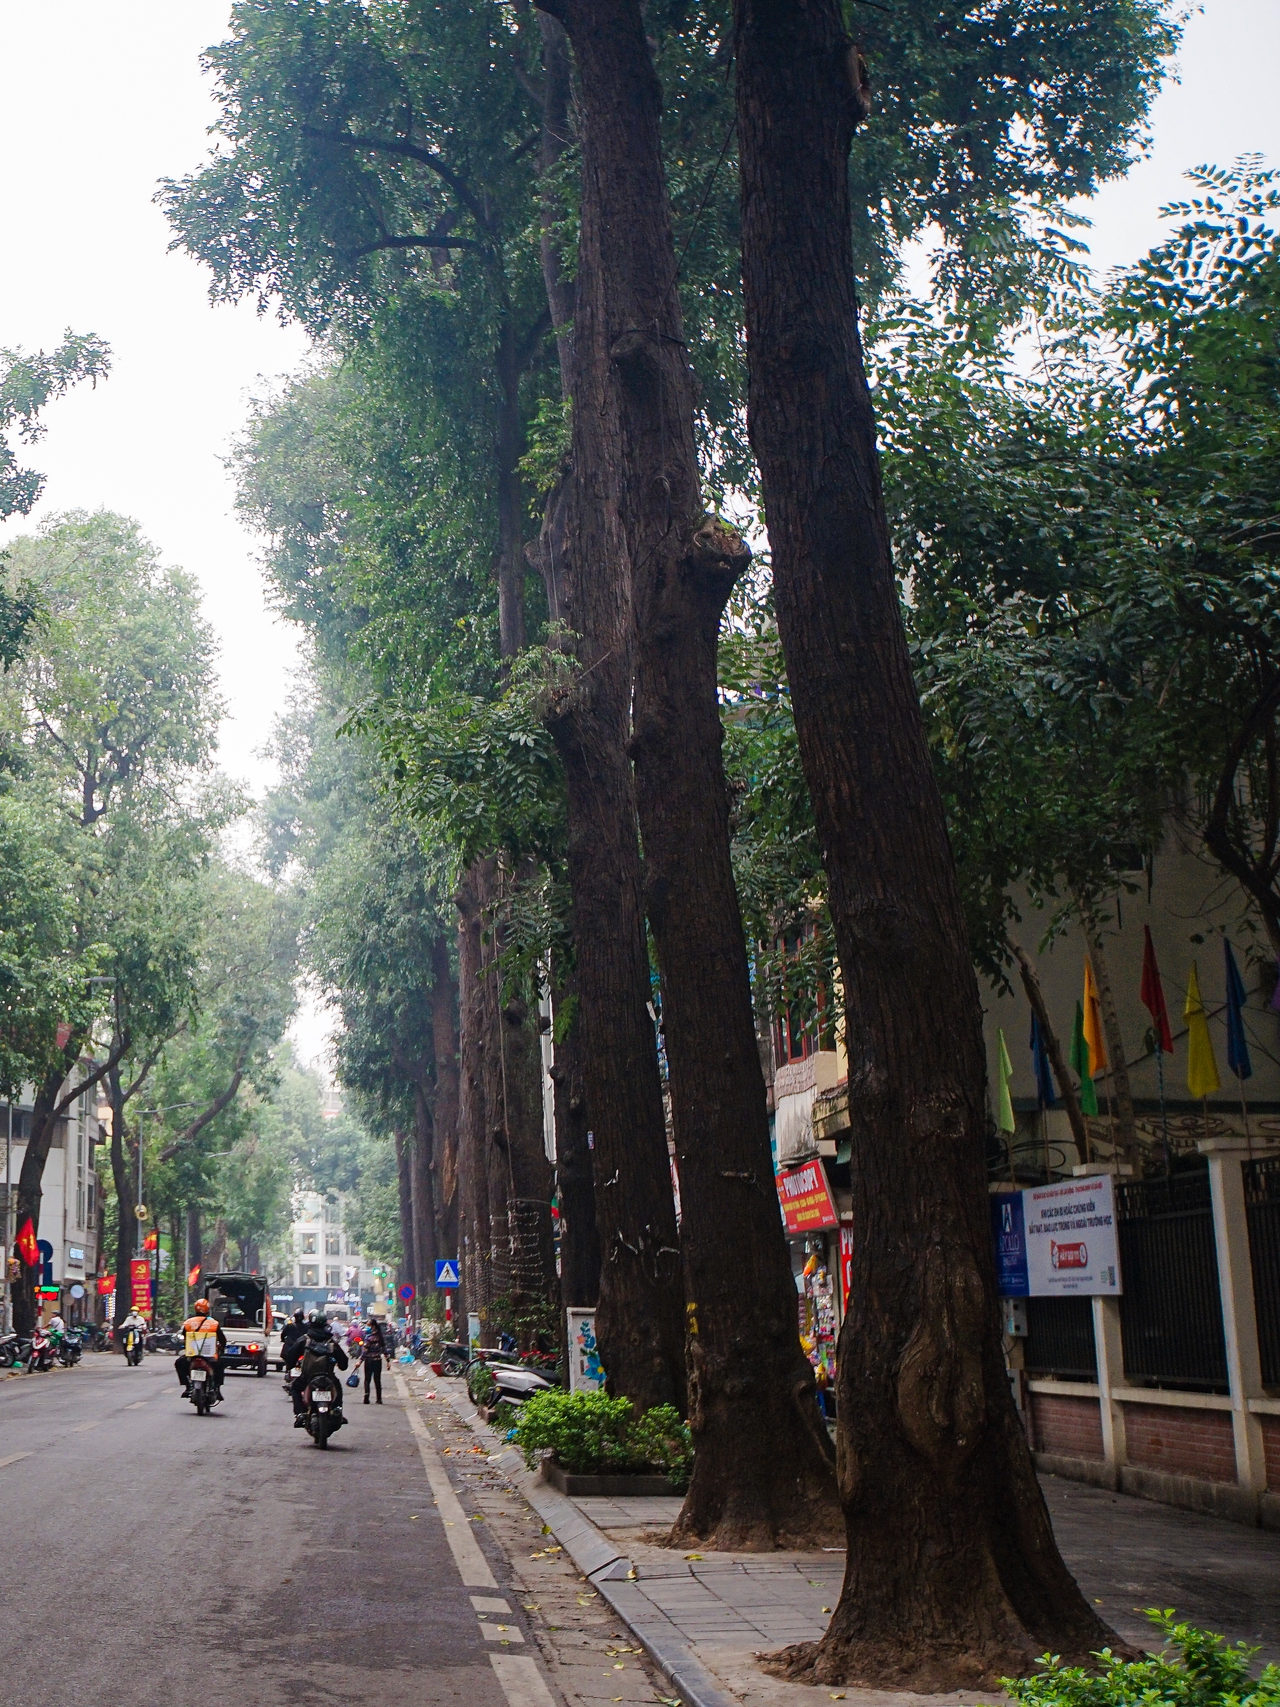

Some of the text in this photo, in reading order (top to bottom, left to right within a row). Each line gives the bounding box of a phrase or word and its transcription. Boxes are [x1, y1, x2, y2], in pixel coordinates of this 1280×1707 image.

[783, 1166, 819, 1198] PHOTOCOPY
[841, 1227, 854, 1255] PH
[1000, 1234, 1020, 1252] APOLLO
